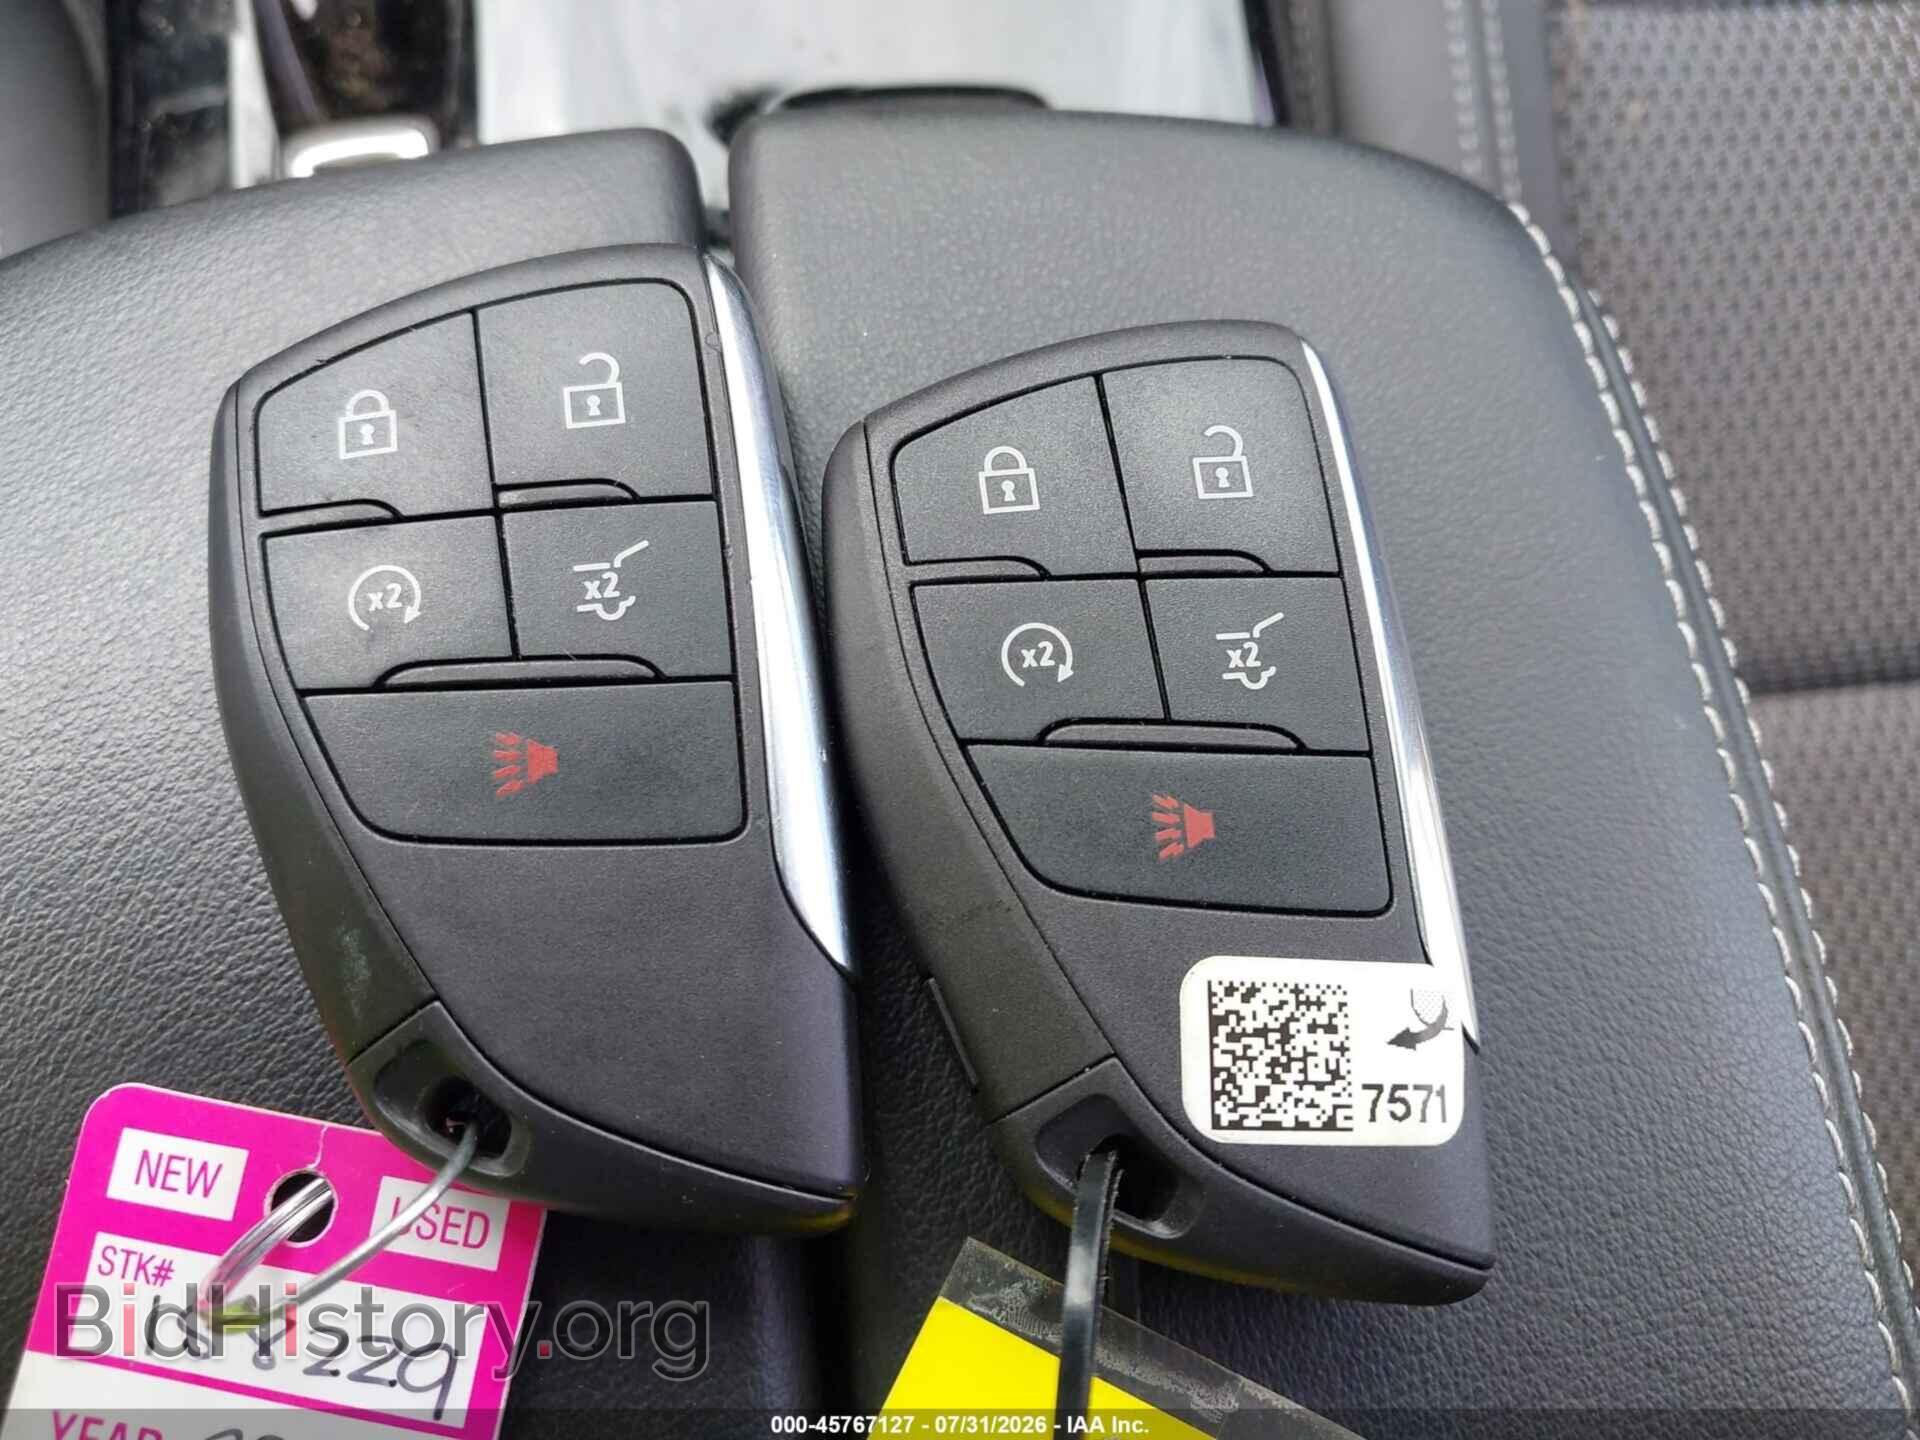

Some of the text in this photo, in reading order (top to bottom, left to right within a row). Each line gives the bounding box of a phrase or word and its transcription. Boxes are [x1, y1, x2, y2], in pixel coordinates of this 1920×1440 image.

[367, 582, 403, 612] x2
[583, 571, 620, 600] x2
[1020, 640, 1056, 668] x2
[1225, 641, 1262, 669] x2
[1361, 1083, 1447, 1124] 7571
[134, 1149, 223, 1198] NEW
[97, 1245, 175, 1287] STK#
